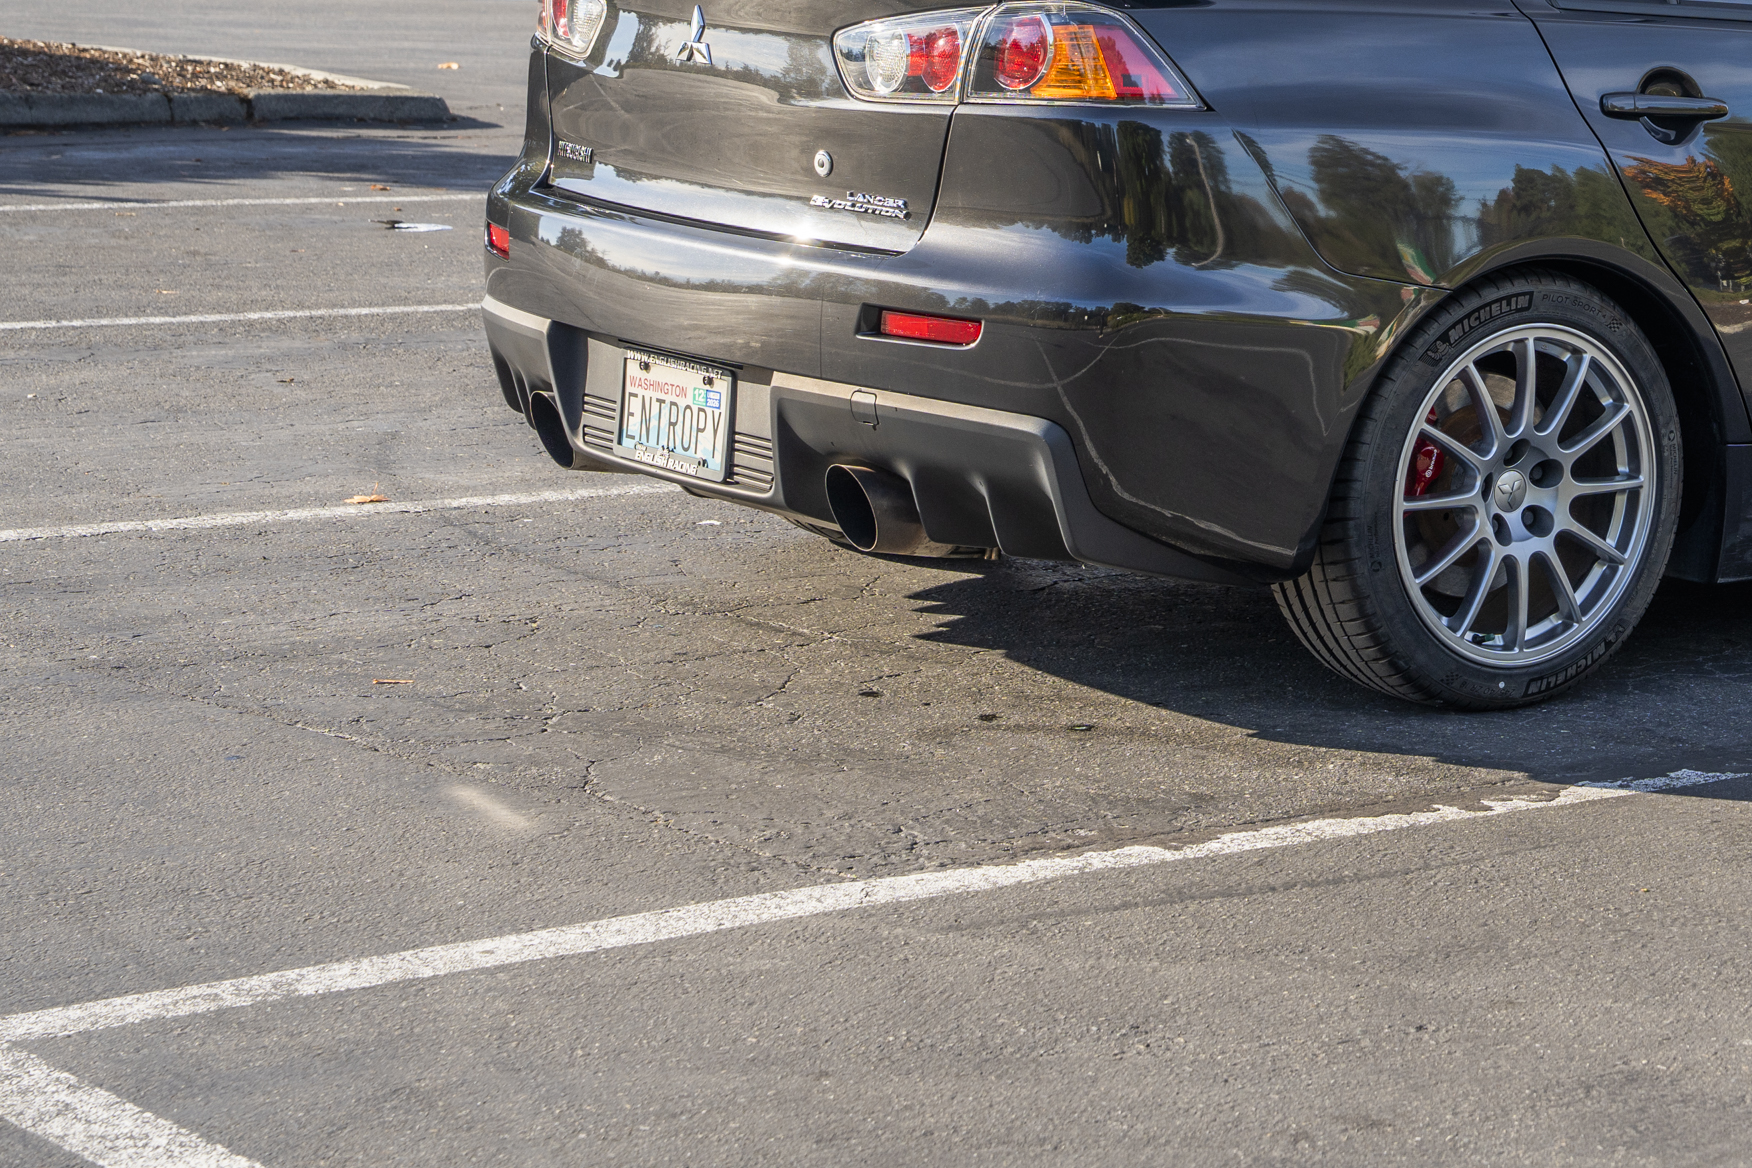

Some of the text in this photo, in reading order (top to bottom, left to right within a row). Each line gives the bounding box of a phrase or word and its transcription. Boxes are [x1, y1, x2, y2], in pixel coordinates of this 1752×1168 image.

[810, 195, 911, 220] EVOLUTION
[846, 191, 908, 209] LANCER
[1542, 294, 1570, 304] PILOT
[1572, 299, 1602, 316] SPORT
[1449, 295, 1530, 344] MICHELIN
[627, 350, 723, 380] WWW.ENGLISHRACING.NET
[629, 375, 688, 399] WASHINGTON
[694, 388, 705, 401] 12
[625, 392, 722, 459] ENTROPY
[635, 450, 698, 476] ENGLISH RACING
[1428, 448, 1438, 470] brembo
[1527, 643, 1606, 695] MICHELIN
